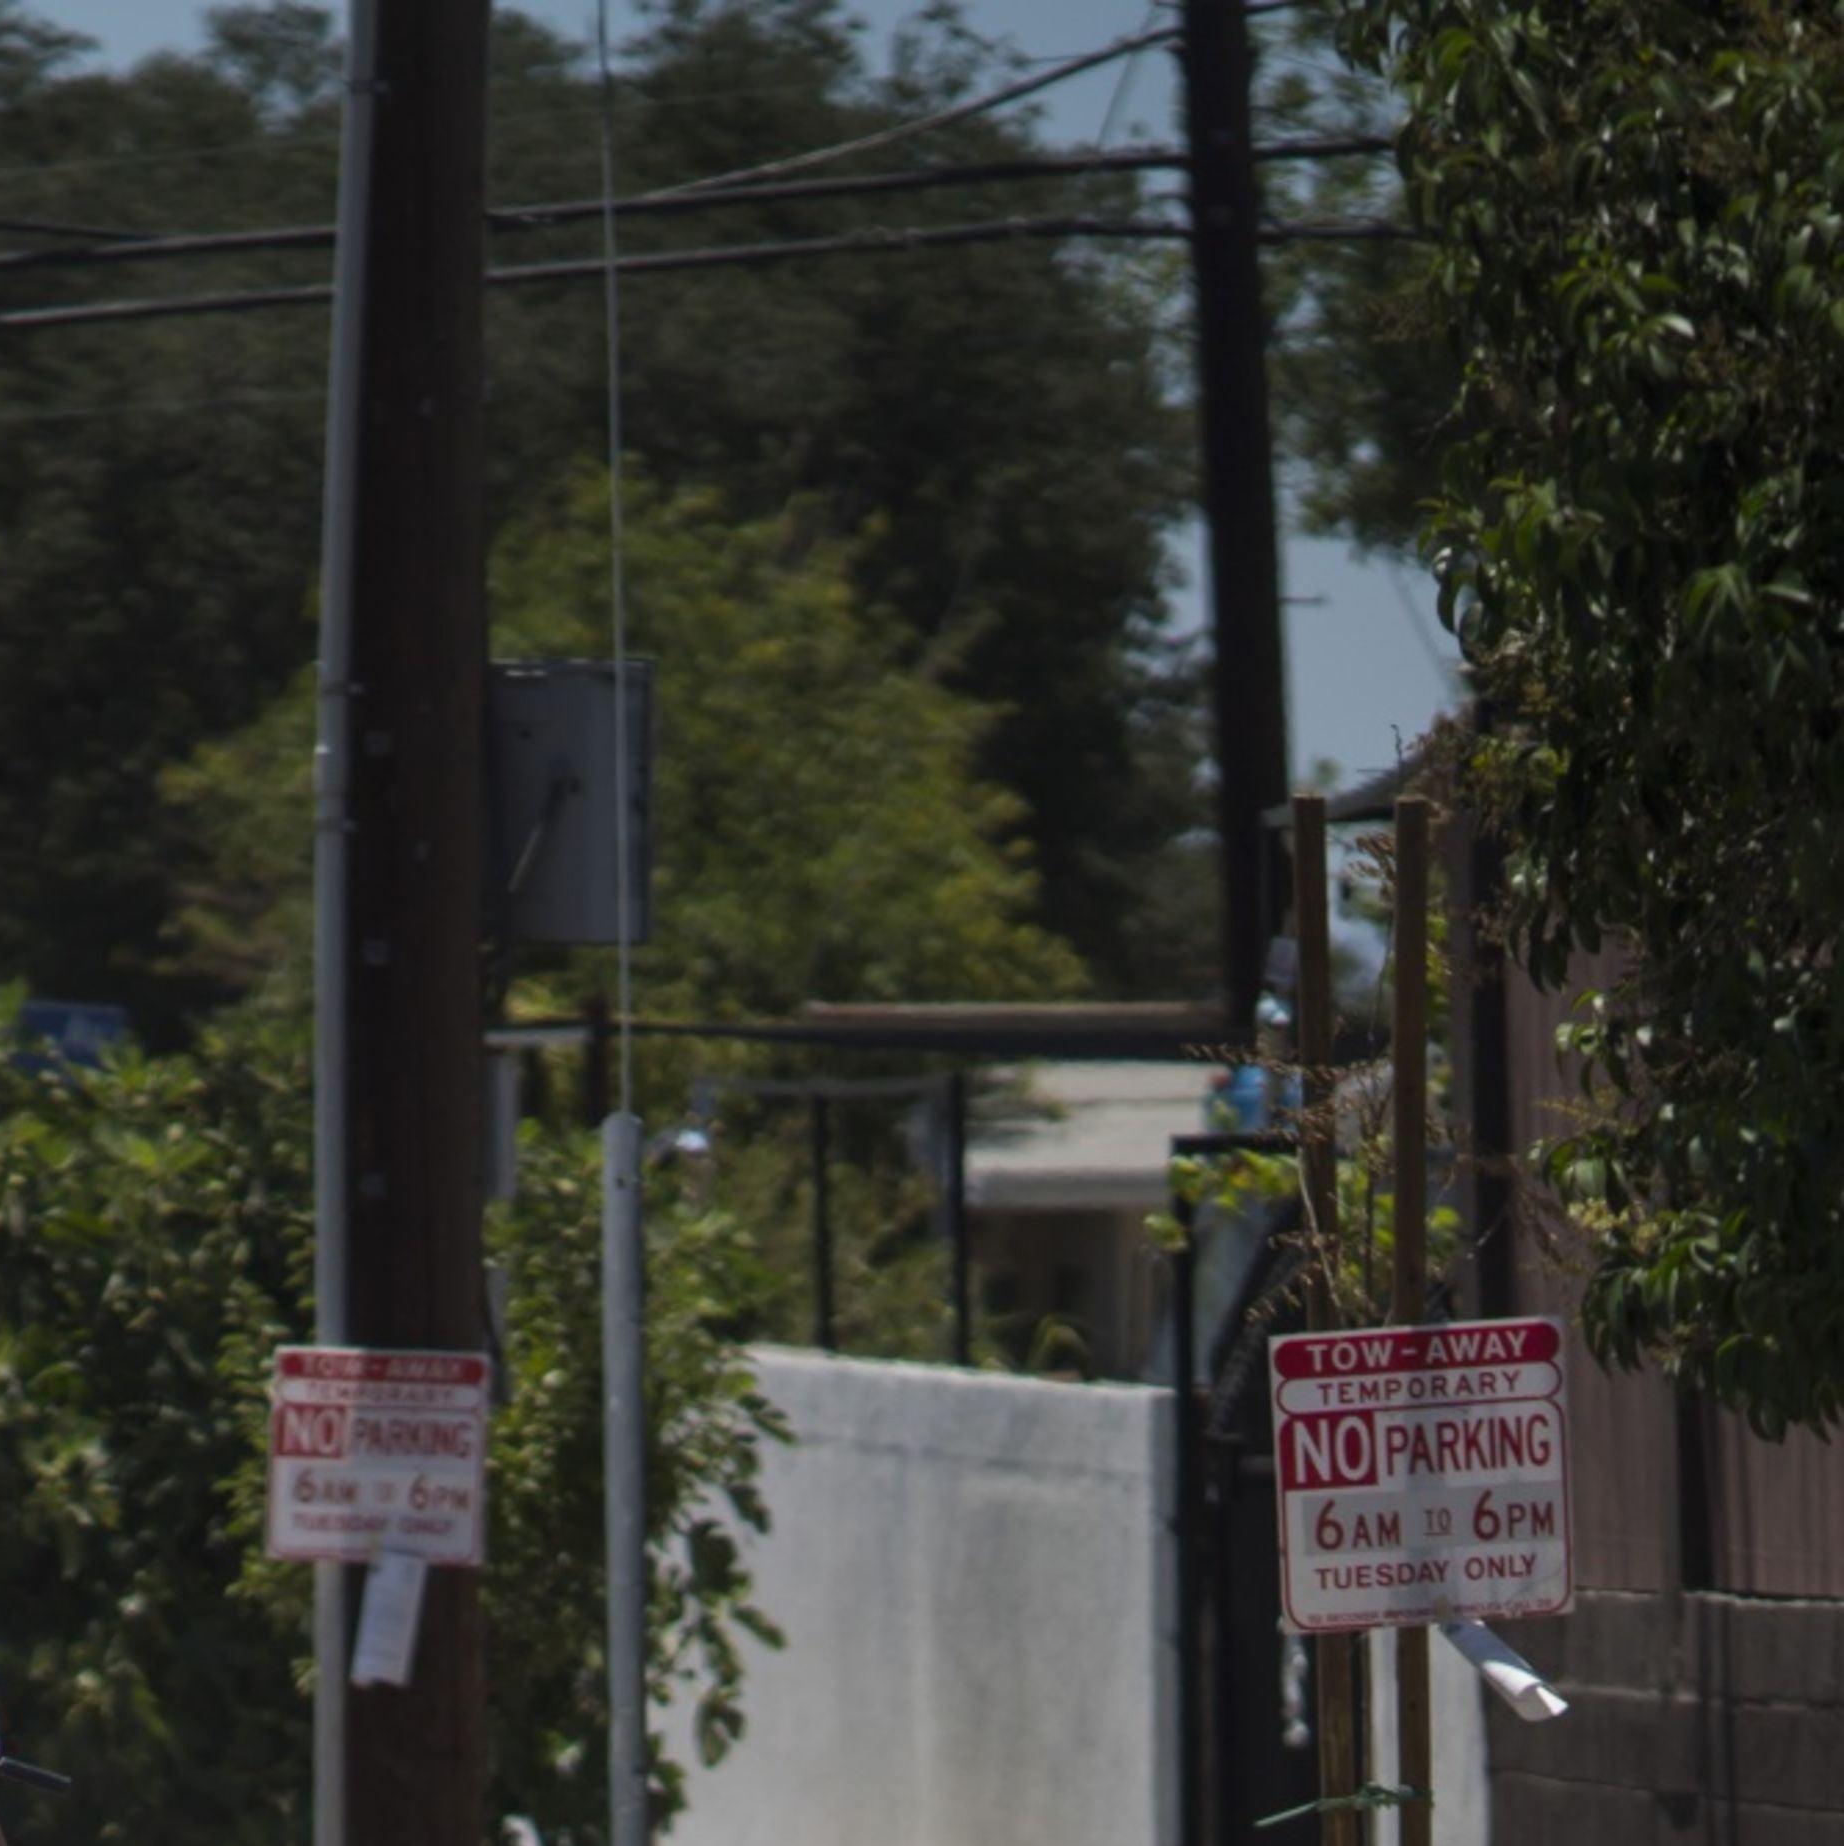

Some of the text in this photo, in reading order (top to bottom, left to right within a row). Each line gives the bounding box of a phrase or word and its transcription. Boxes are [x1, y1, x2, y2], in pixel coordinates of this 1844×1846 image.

[1318, 1371, 1522, 1405] TEMPORARY
[284, 1405, 471, 1458] NO PARKING
[1293, 1414, 1550, 1484] NO PARKING
[1424, 1508, 1452, 1535] TO
[1315, 1553, 1537, 1590] TUESDAY ONLY
